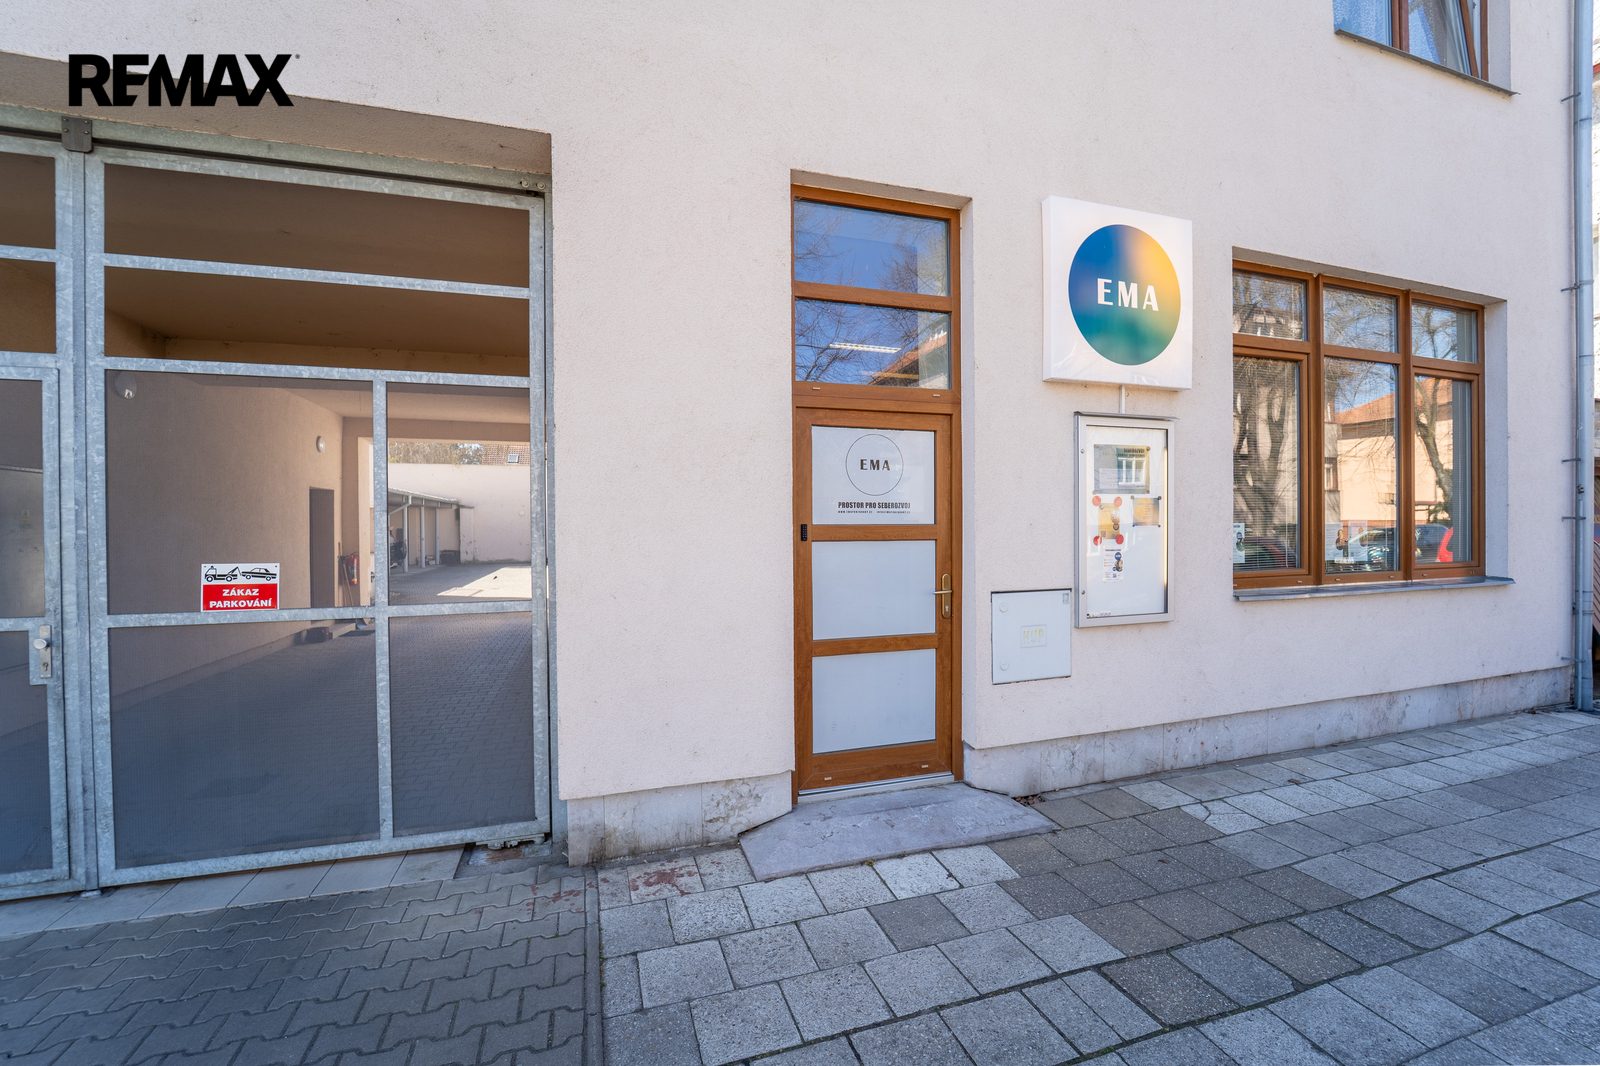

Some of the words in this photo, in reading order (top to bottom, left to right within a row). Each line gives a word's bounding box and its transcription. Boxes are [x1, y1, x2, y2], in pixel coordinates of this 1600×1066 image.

[1097, 278, 1159, 312] EMA
[860, 458, 891, 471] EMA
[838, 501, 864, 509] PROSTOR
[865, 501, 877, 509] PRO
[222, 587, 259, 597] ZÁKAZ
[209, 598, 272, 608] PARKOVÁNÍ
